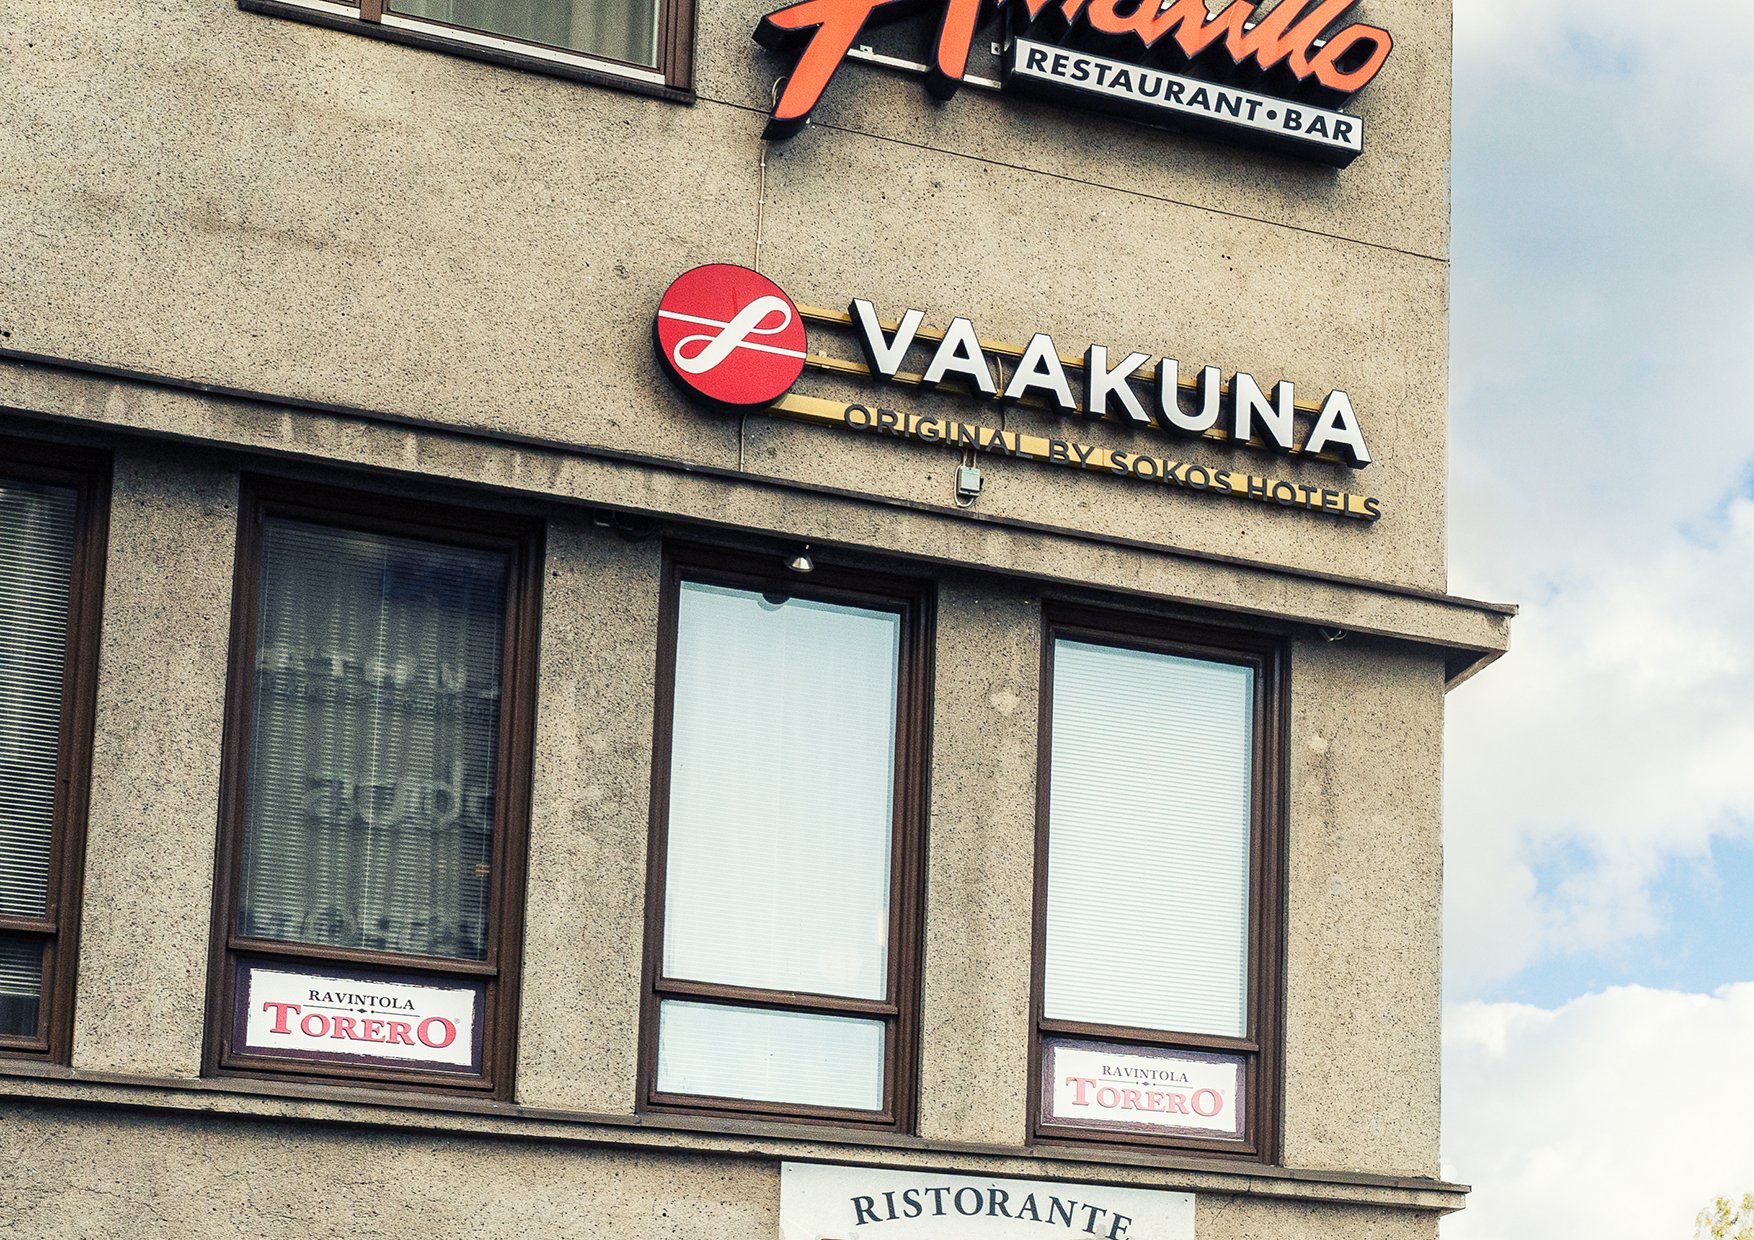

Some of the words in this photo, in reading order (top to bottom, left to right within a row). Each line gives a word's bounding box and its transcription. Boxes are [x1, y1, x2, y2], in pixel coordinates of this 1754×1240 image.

[1026, 48, 1263, 121] RESTAURANT
[1282, 112, 1354, 144] BAR
[850, 297, 1372, 466] VAAKUNA
[844, 403, 1034, 460] ORIGINAL
[1049, 438, 1096, 469] BY
[1110, 449, 1233, 495] SOKOS
[1246, 475, 1382, 522] HOTELS
[308, 989, 416, 1011] RAVINTOLA
[262, 1001, 457, 1049] TORERO
[1065, 1076, 1224, 1118] TORERO
[1102, 1065, 1189, 1083] RAVINTOLA
